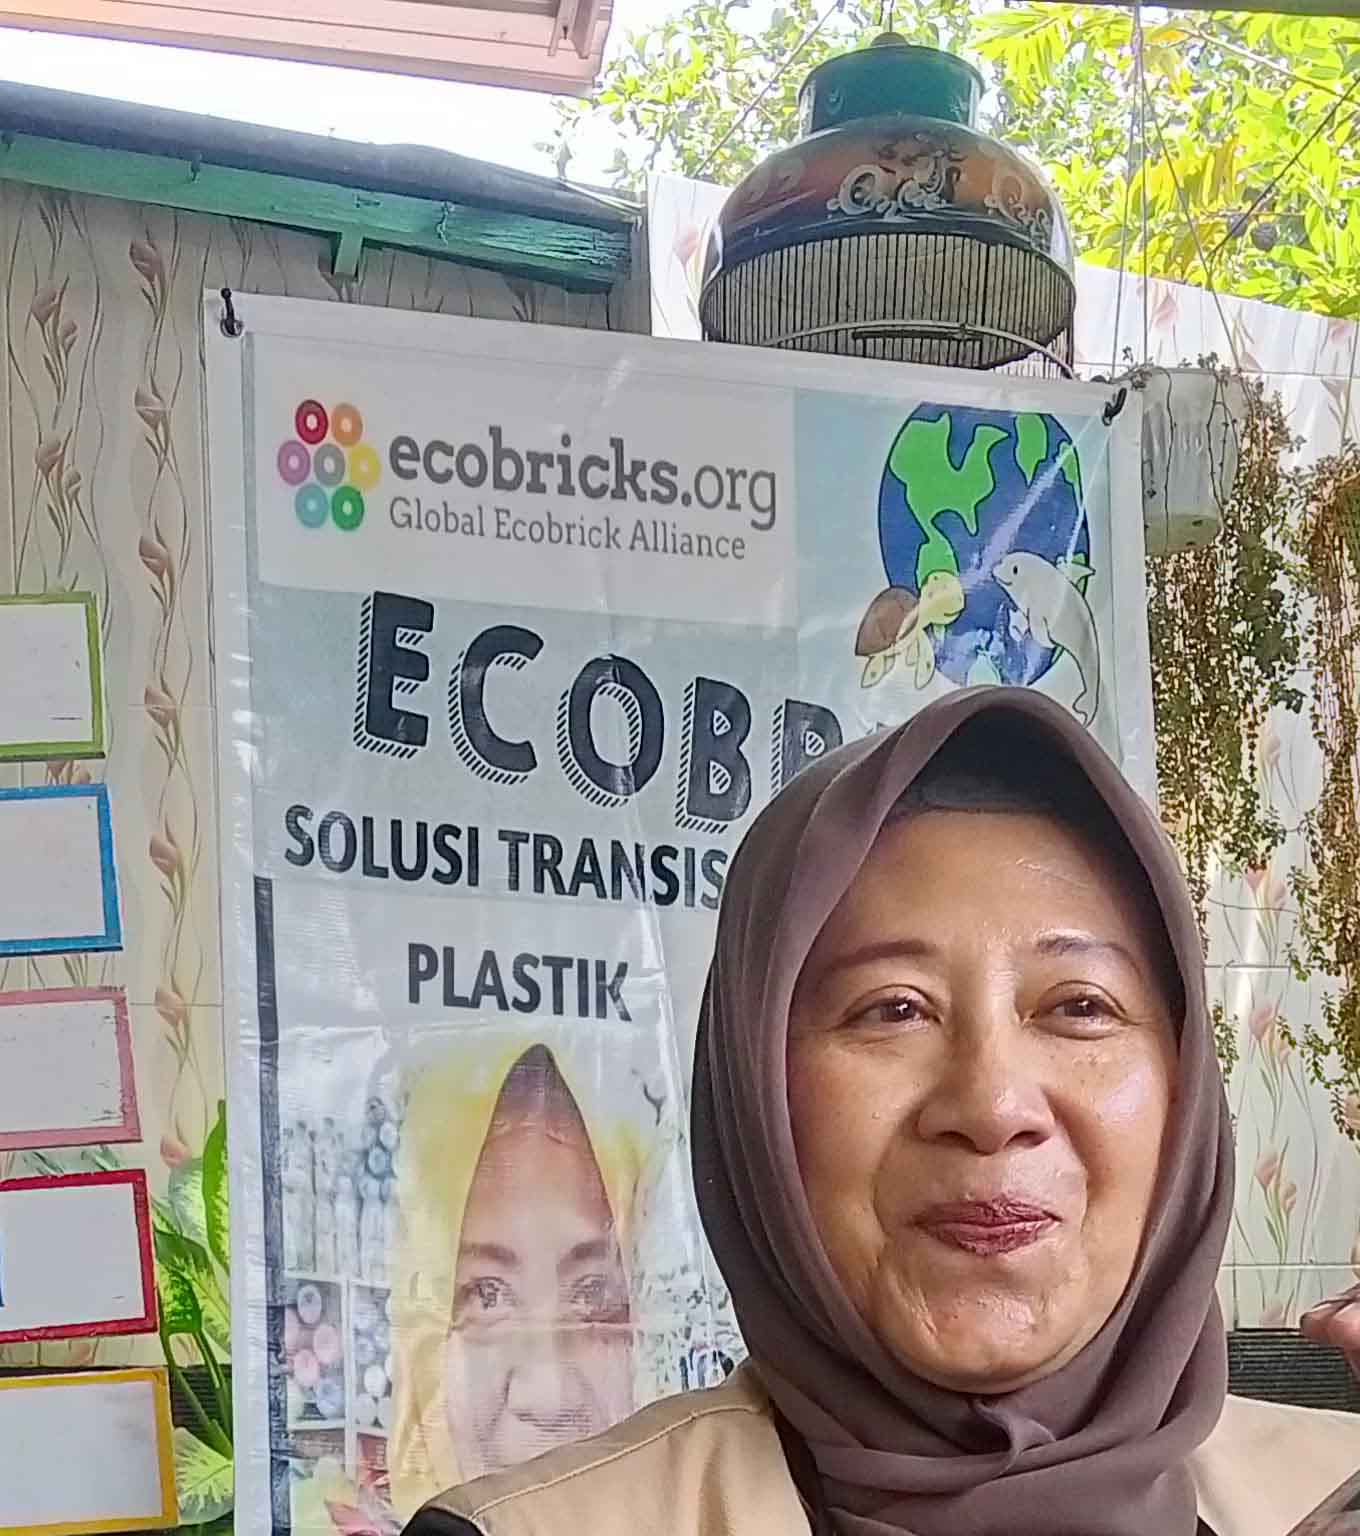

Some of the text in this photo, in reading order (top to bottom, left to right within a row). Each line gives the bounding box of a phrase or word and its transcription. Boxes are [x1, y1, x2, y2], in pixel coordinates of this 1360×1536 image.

[389, 425, 778, 532] ecobricks.org
[390, 495, 746, 561] Global Ecobrick Alliance
[283, 802, 480, 889] SOLUSI
[406, 942, 629, 1021] PLASTIK
